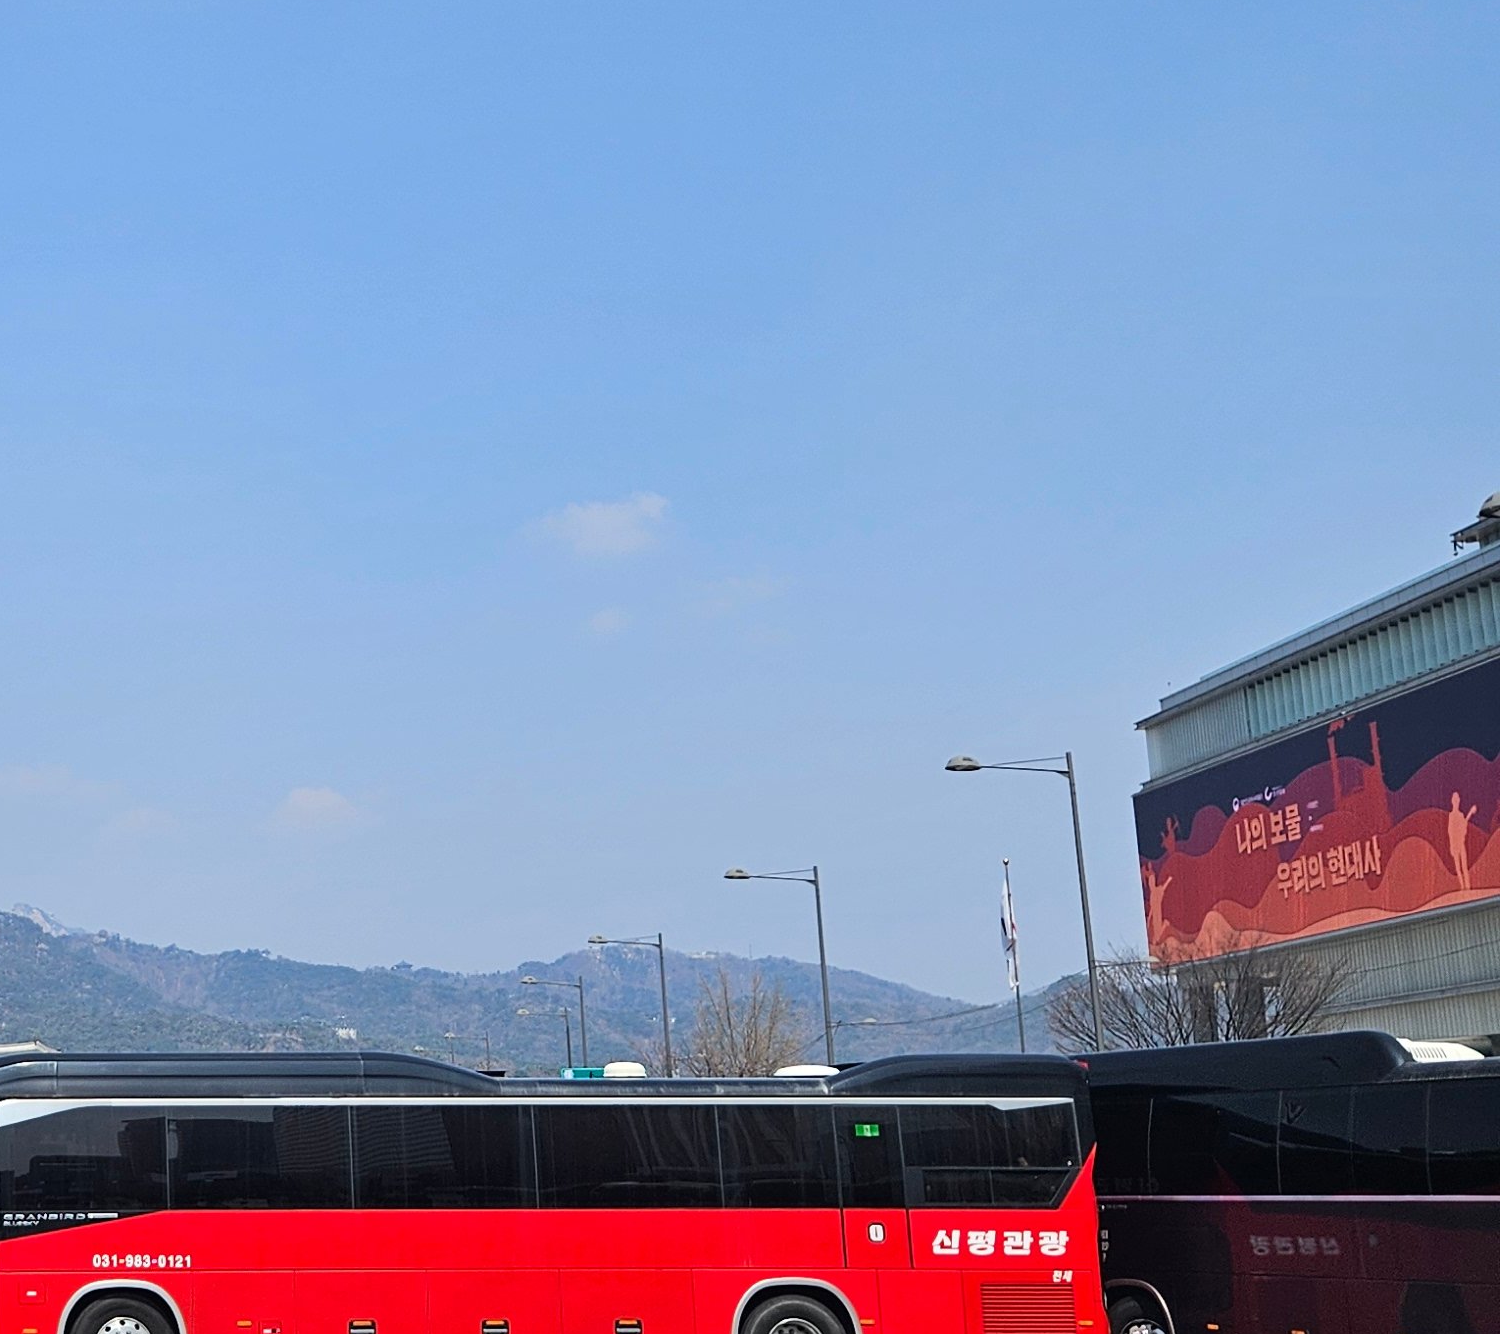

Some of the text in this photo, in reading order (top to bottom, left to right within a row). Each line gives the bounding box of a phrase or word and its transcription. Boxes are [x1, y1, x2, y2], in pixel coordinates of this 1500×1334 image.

[1235, 803, 1301, 854] 나의 보물
[1277, 834, 1381, 899] 우리의 현대사
[3, 1212, 86, 1220] GRANBIRD
[932, 1229, 1070, 1256] 신평관광
[92, 1253, 192, 1268] 031-983-0121
